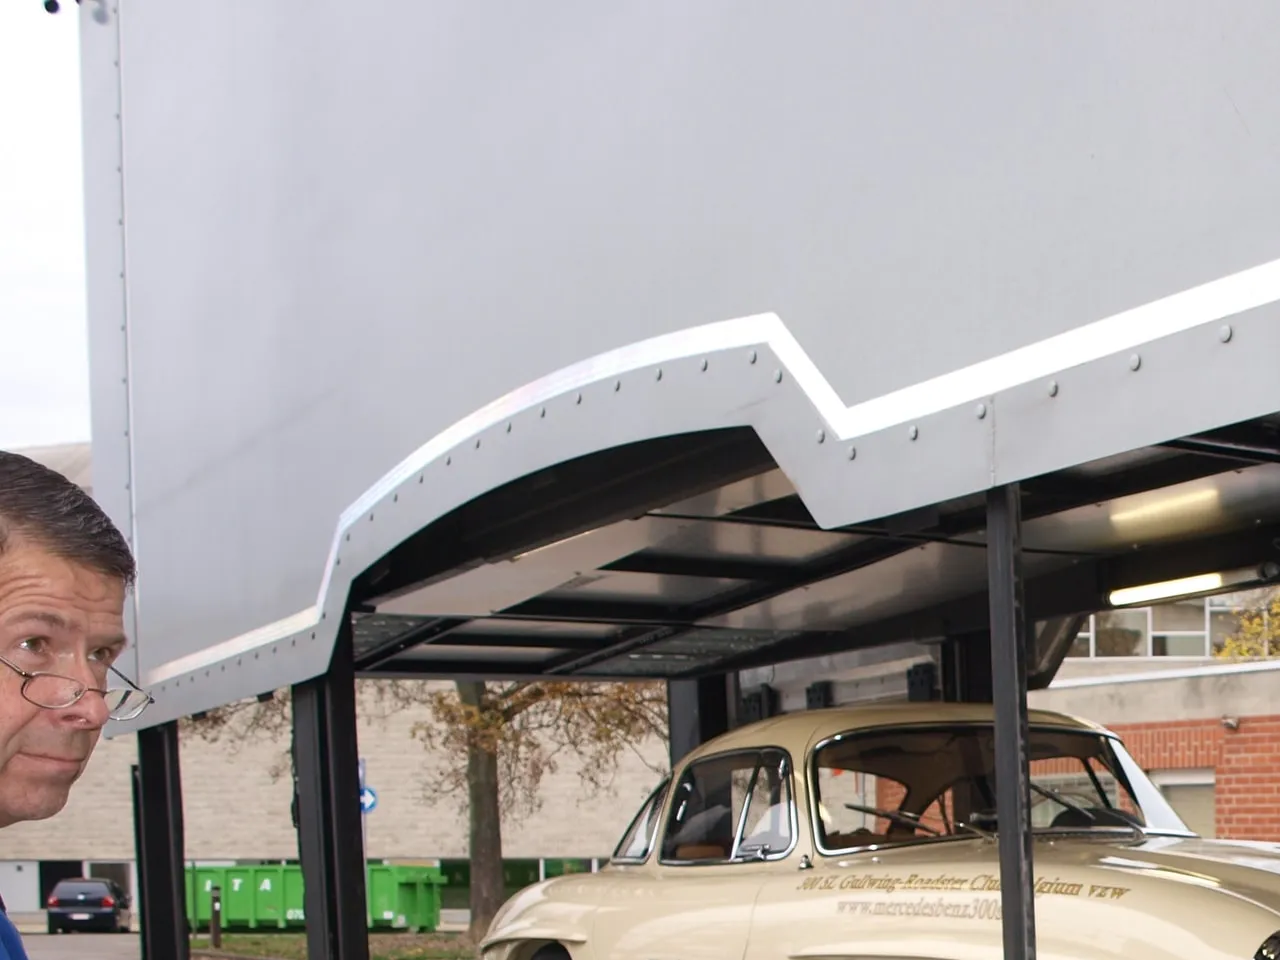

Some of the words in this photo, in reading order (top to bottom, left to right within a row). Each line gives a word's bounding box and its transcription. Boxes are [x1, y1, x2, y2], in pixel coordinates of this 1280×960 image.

[969, 874, 1001, 892] Clu
[1034, 877, 1083, 898] lgium
[836, 897, 1002, 920] www.mercedesbenz300s
